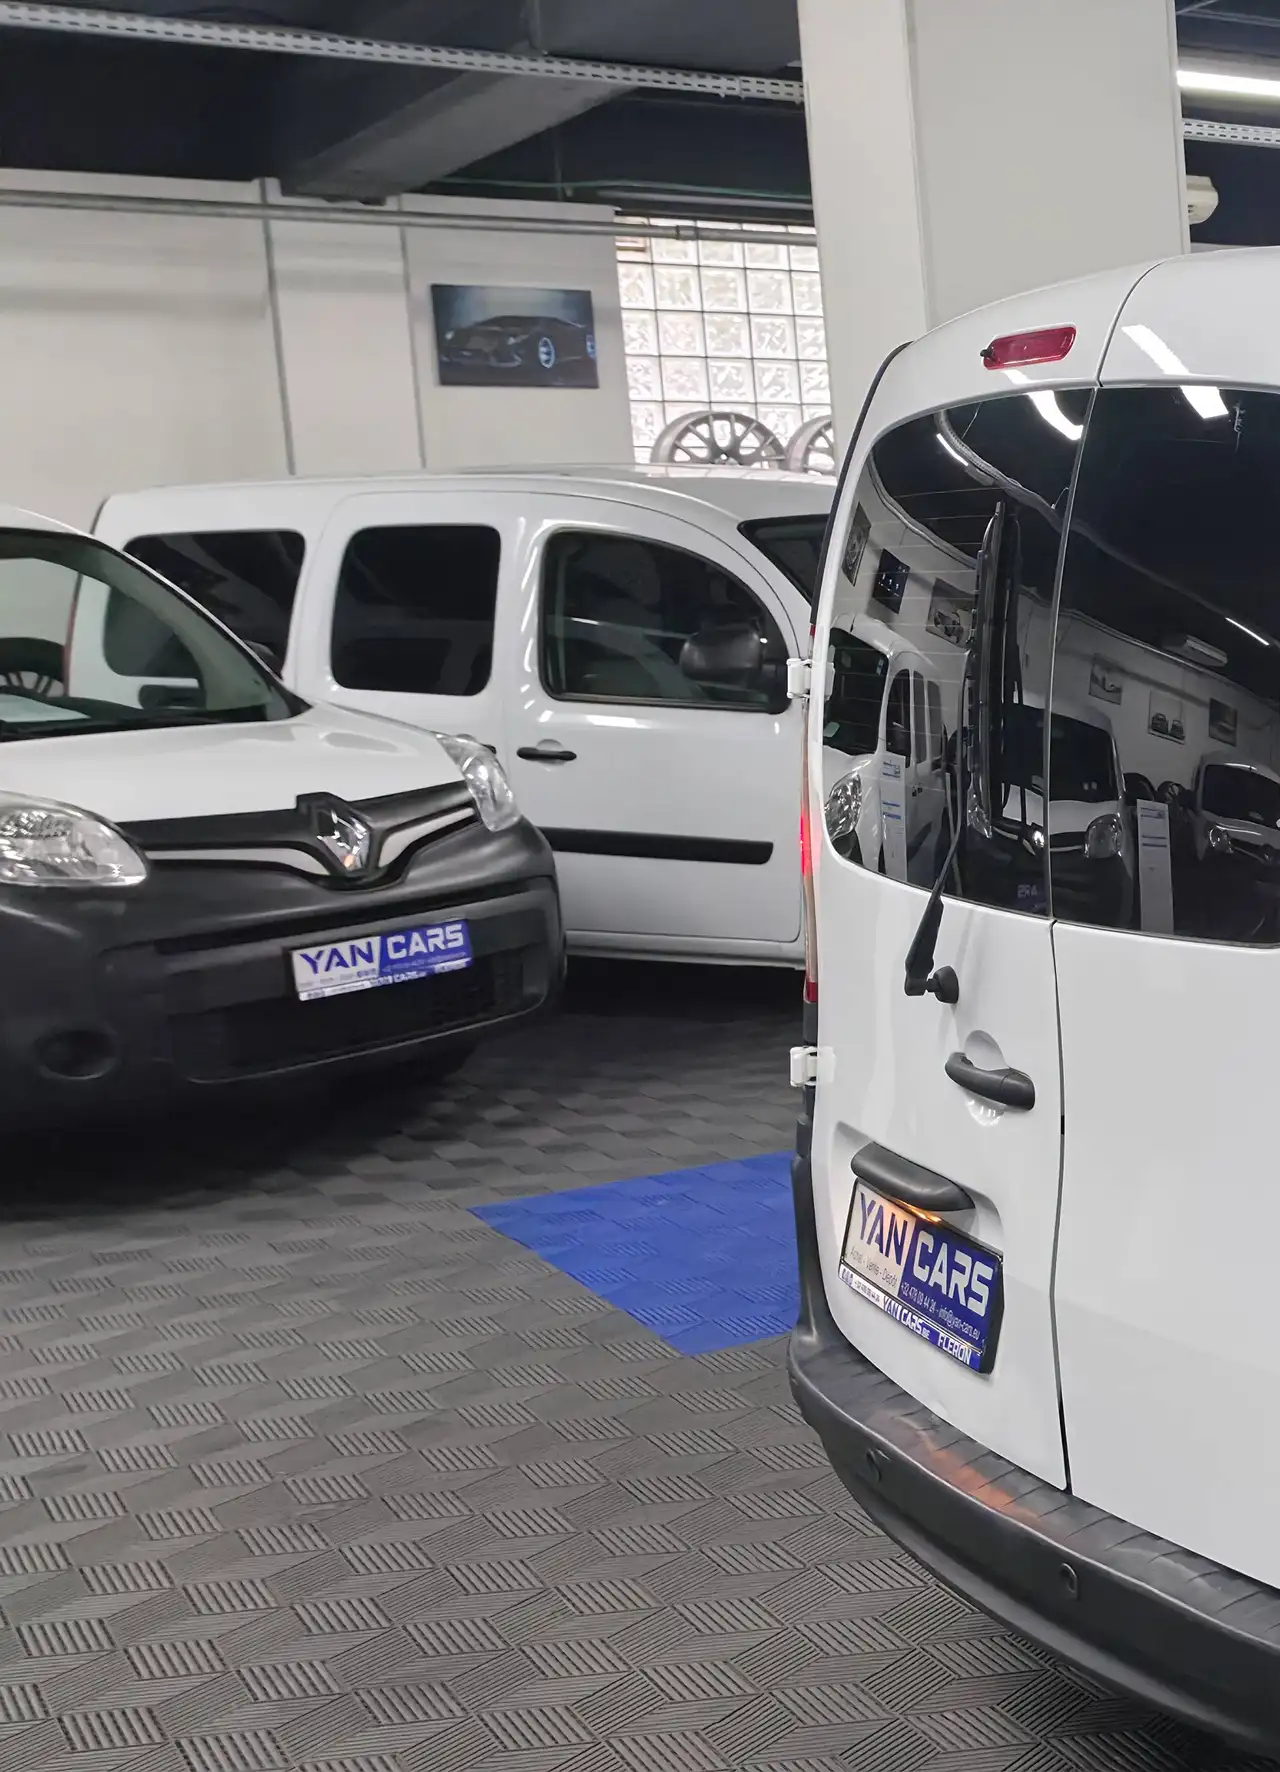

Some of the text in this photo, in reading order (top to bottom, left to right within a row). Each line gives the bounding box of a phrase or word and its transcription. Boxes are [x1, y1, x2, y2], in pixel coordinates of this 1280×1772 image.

[300, 941, 374, 975] YAN
[387, 923, 464, 960] CARS
[860, 1192, 994, 1317] YAN CARS
[938, 1333, 972, 1365] FLERON
